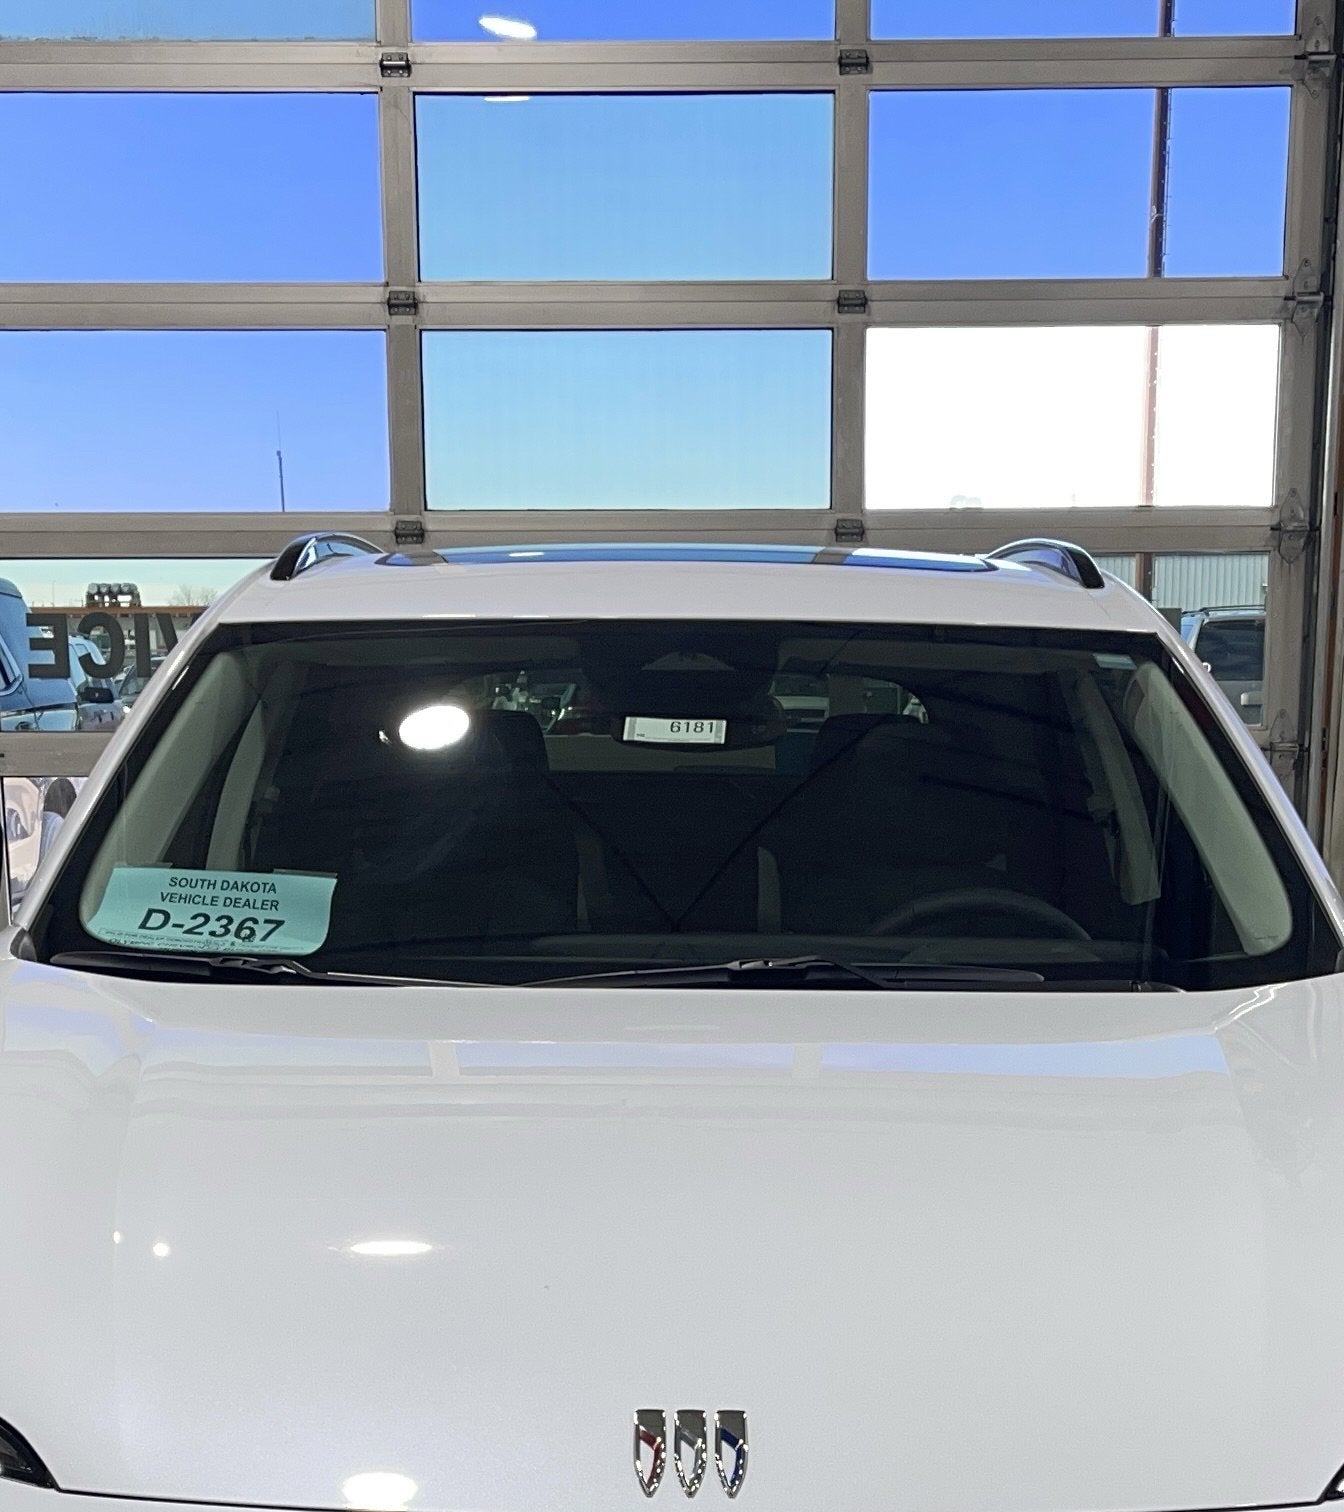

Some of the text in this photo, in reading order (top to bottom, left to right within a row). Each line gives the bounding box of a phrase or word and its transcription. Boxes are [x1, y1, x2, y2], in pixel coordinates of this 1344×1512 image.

[670, 721, 714, 734] 6181
[168, 876, 277, 895] SOUTH DAKOTA
[160, 891, 280, 912] VEHICLE DEALER
[138, 907, 286, 943] D-2367
